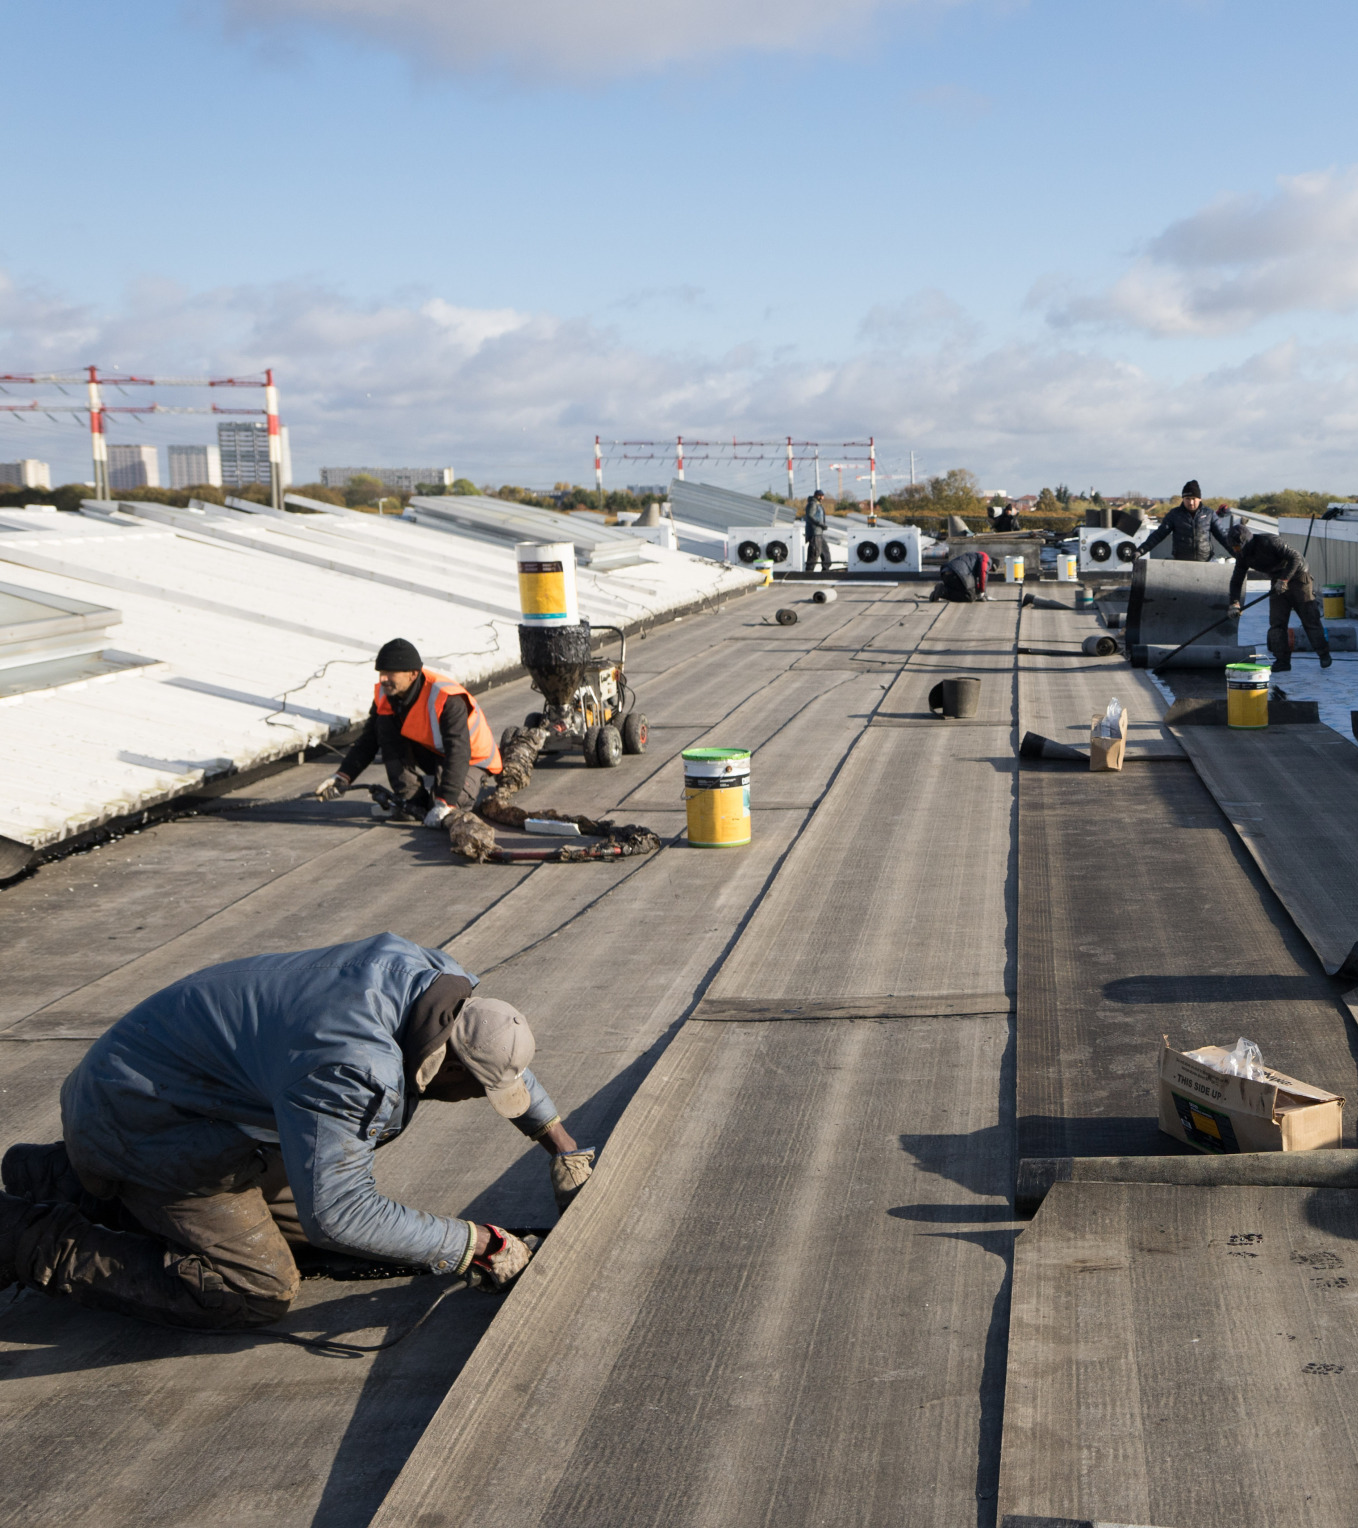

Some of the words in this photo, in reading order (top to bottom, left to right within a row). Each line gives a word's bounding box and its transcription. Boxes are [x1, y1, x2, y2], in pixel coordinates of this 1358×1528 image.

[1177, 1073, 1193, 1088] THIS
[1194, 1081, 1210, 1096] SIDE
[1211, 1089, 1222, 1101] UP
